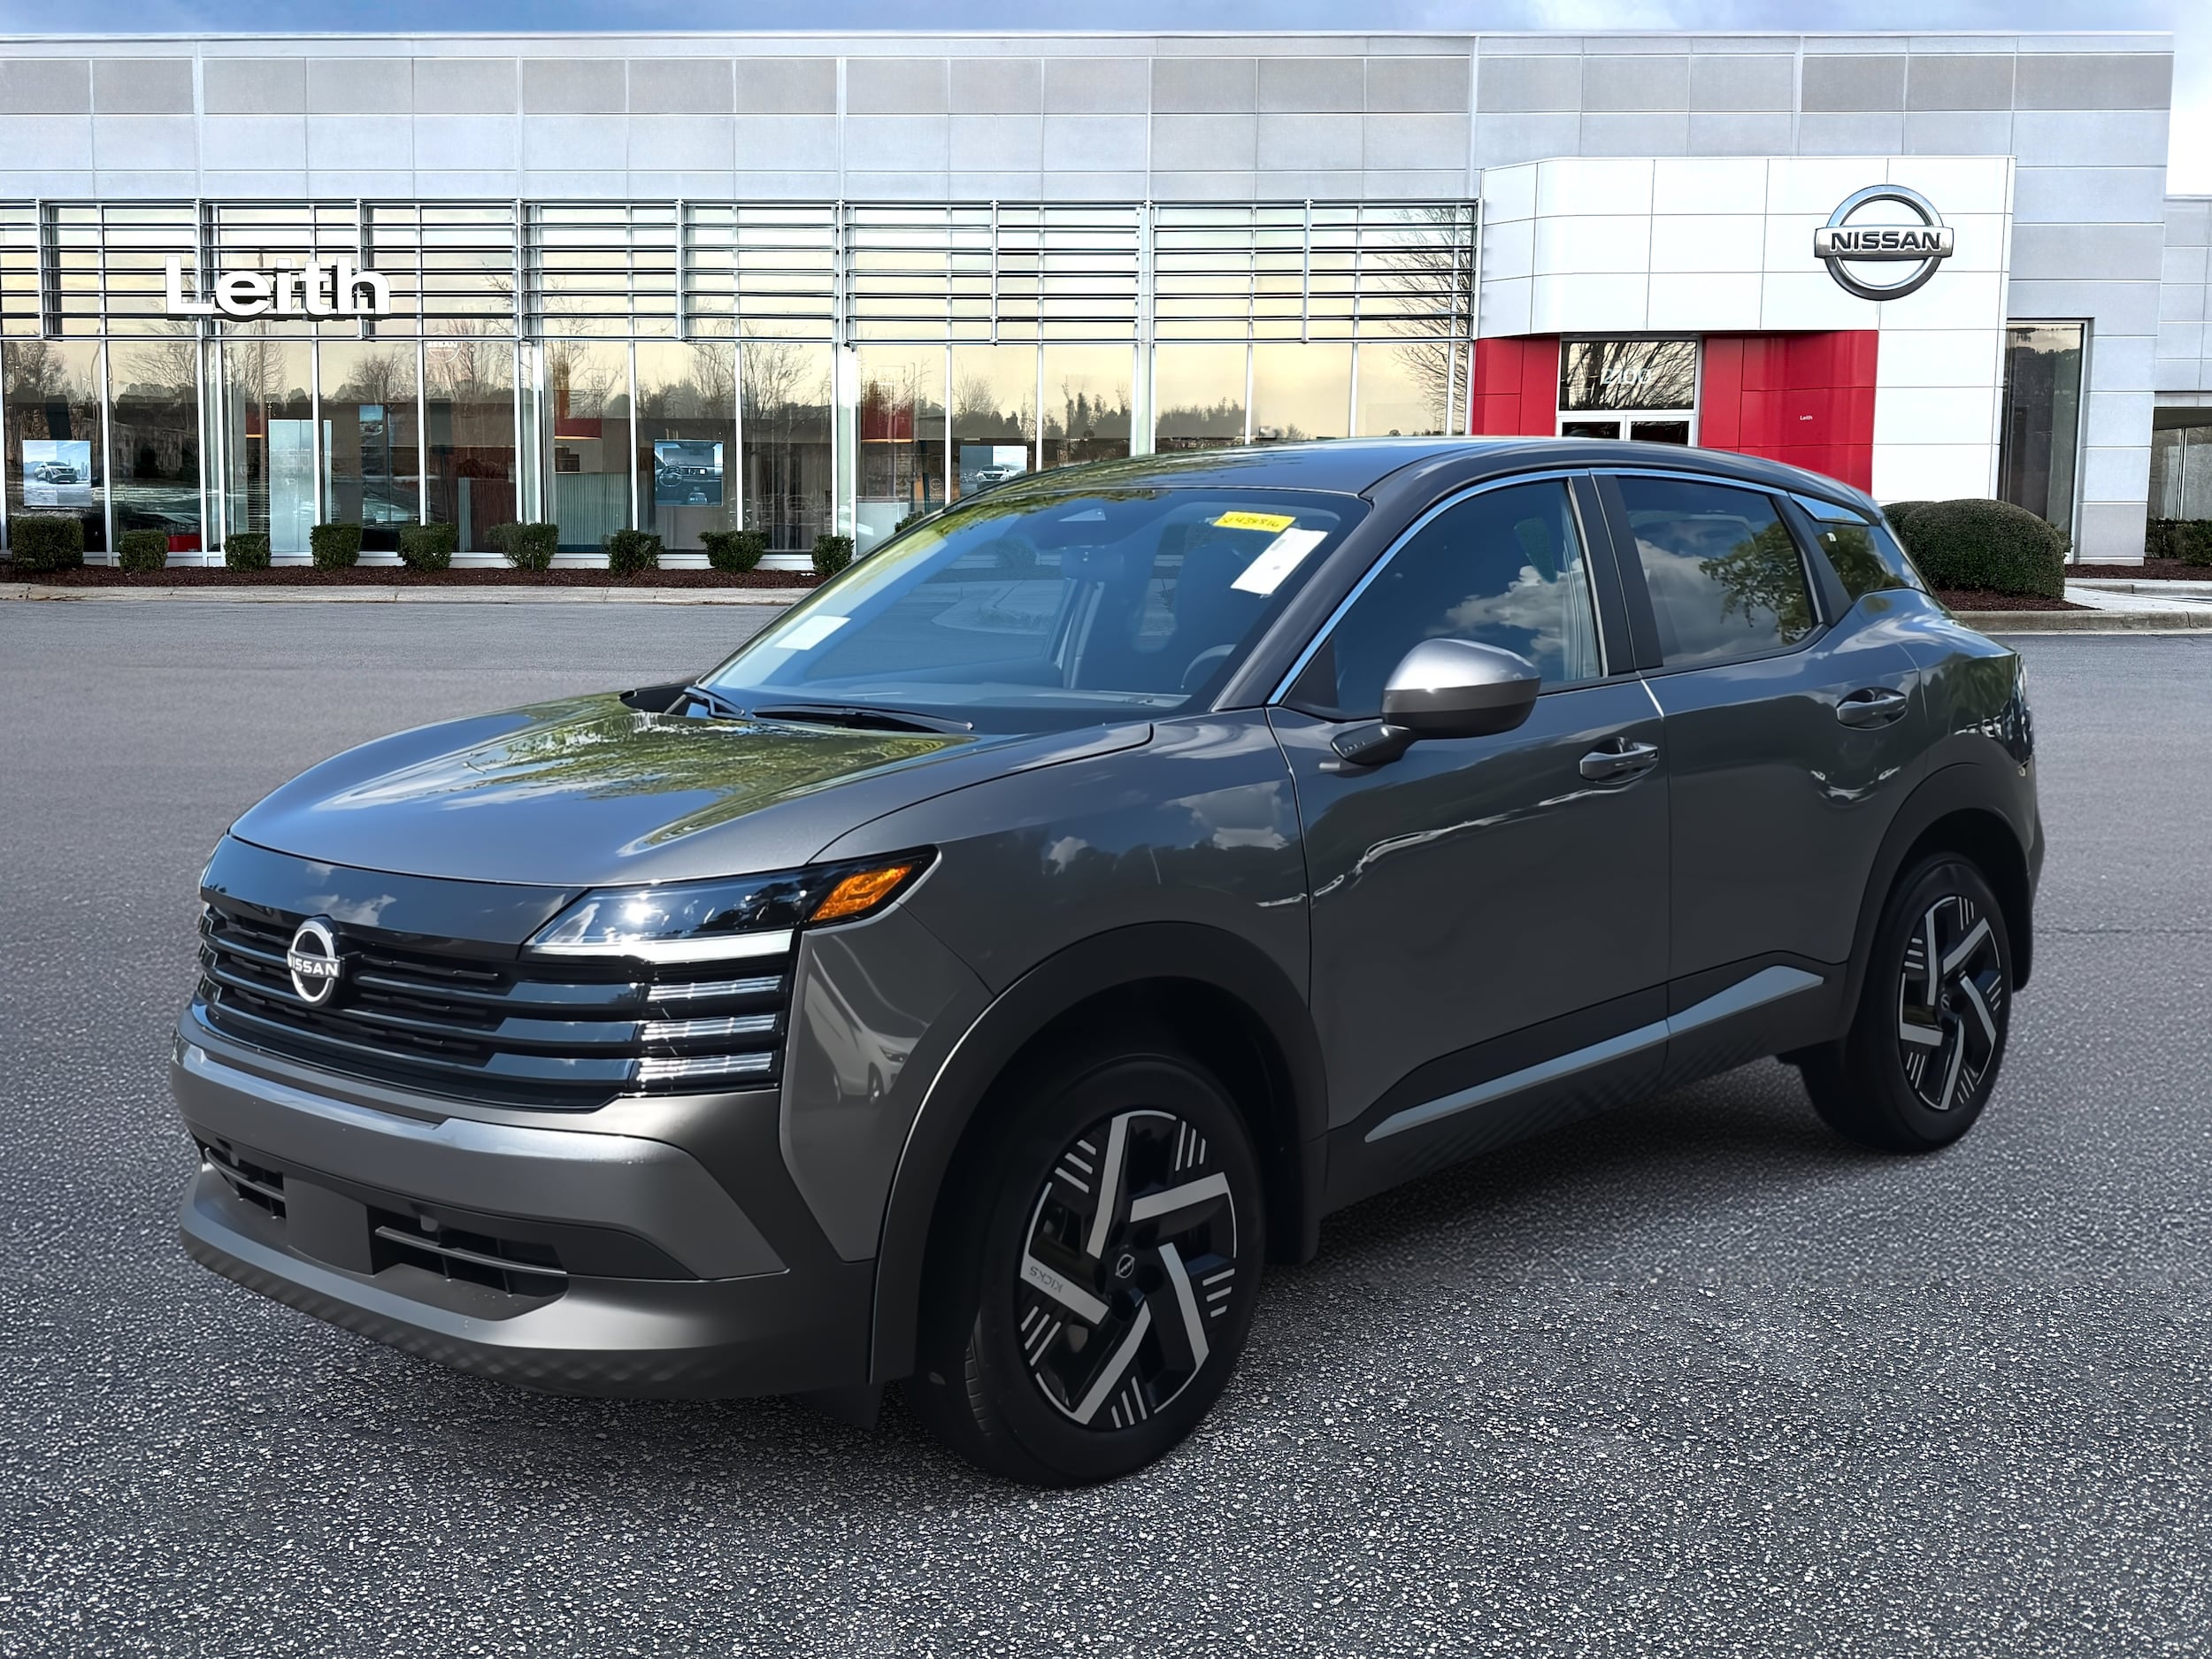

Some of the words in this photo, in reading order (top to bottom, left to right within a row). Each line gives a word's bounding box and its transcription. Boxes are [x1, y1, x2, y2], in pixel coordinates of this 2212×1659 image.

[1830, 230, 1941, 251] NISSAN
[165, 256, 391, 317] Leith
[1029, 1265, 1064, 1293] KICKS
